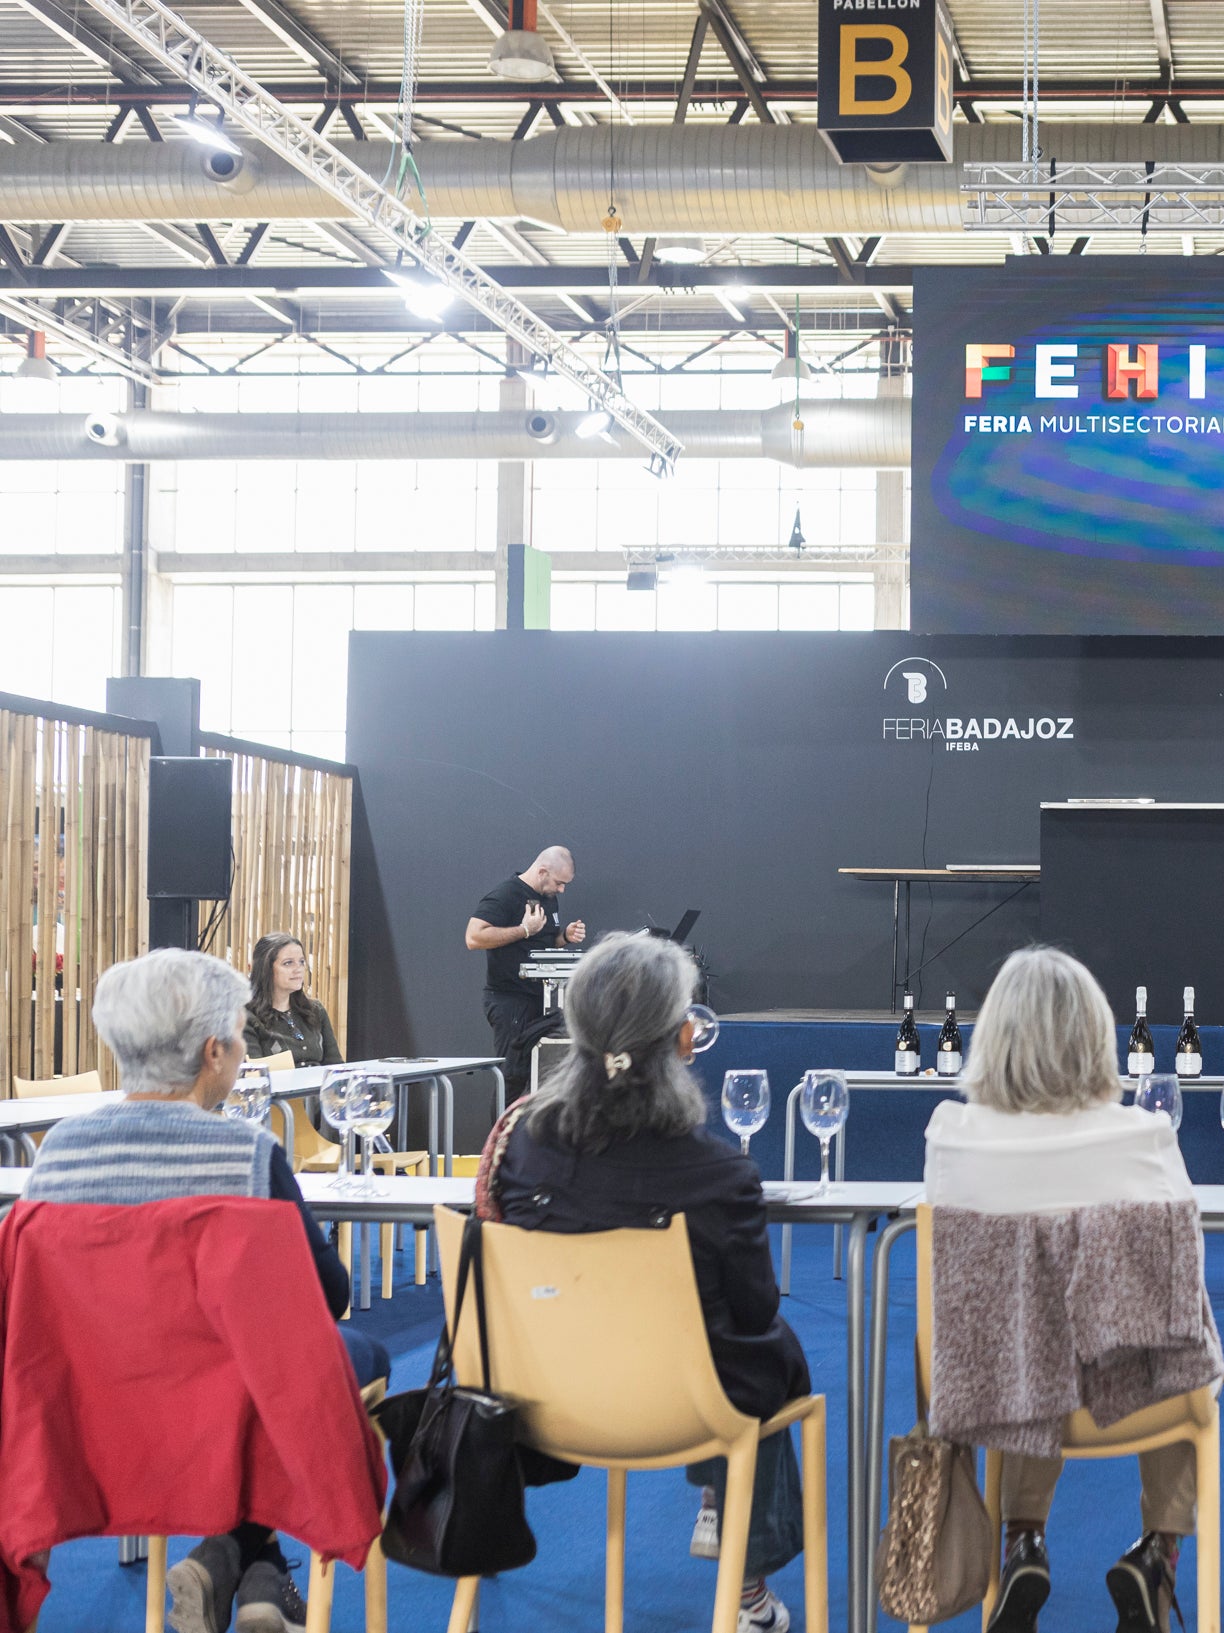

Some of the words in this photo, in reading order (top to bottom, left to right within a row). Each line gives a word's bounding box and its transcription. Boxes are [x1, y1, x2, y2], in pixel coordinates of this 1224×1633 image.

[833, 0, 920, 10] PABELLON
[838, 24, 912, 115] B
[964, 415, 1032, 433] FERIA
[946, 742, 979, 751] IFEBA
